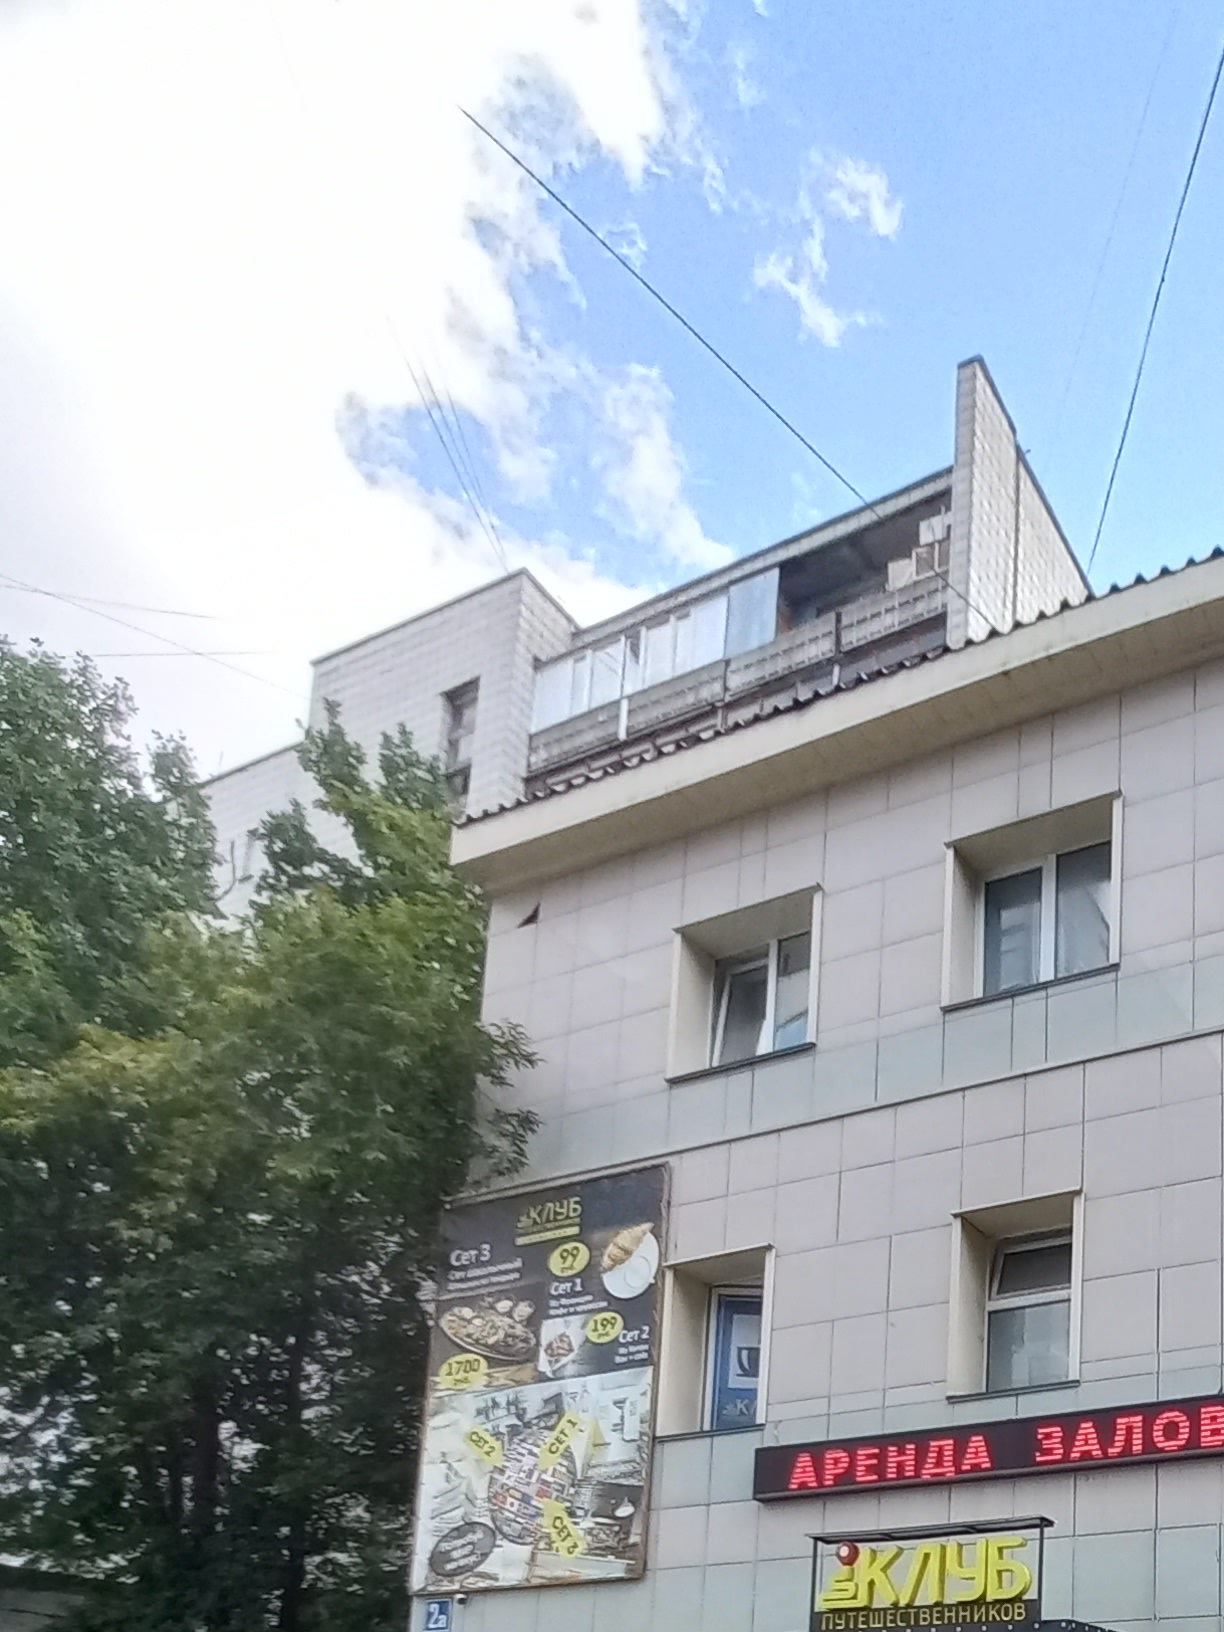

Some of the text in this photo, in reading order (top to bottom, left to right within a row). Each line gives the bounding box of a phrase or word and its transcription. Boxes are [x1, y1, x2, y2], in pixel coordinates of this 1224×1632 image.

[527, 1197, 582, 1226] КЛУБ
[450, 1243, 492, 1267] Сет 3
[559, 1246, 580, 1262] 99
[550, 1278, 584, 1296] Сет 1
[591, 1316, 618, 1333] 199
[618, 1325, 650, 1344] Сет 2
[444, 1358, 481, 1377] 1700
[468, 1431, 496, 1457] СЕТ 2
[550, 1418, 578, 1455] СЕТ 1
[788, 1434, 993, 1490] АРЕНДА
[551, 1516, 579, 1555] СЕТ 3
[857, 1535, 1032, 1608] КЛУБ
[820, 1603, 1027, 1631] ПУТЕШЕСТВЕННИКОВ
